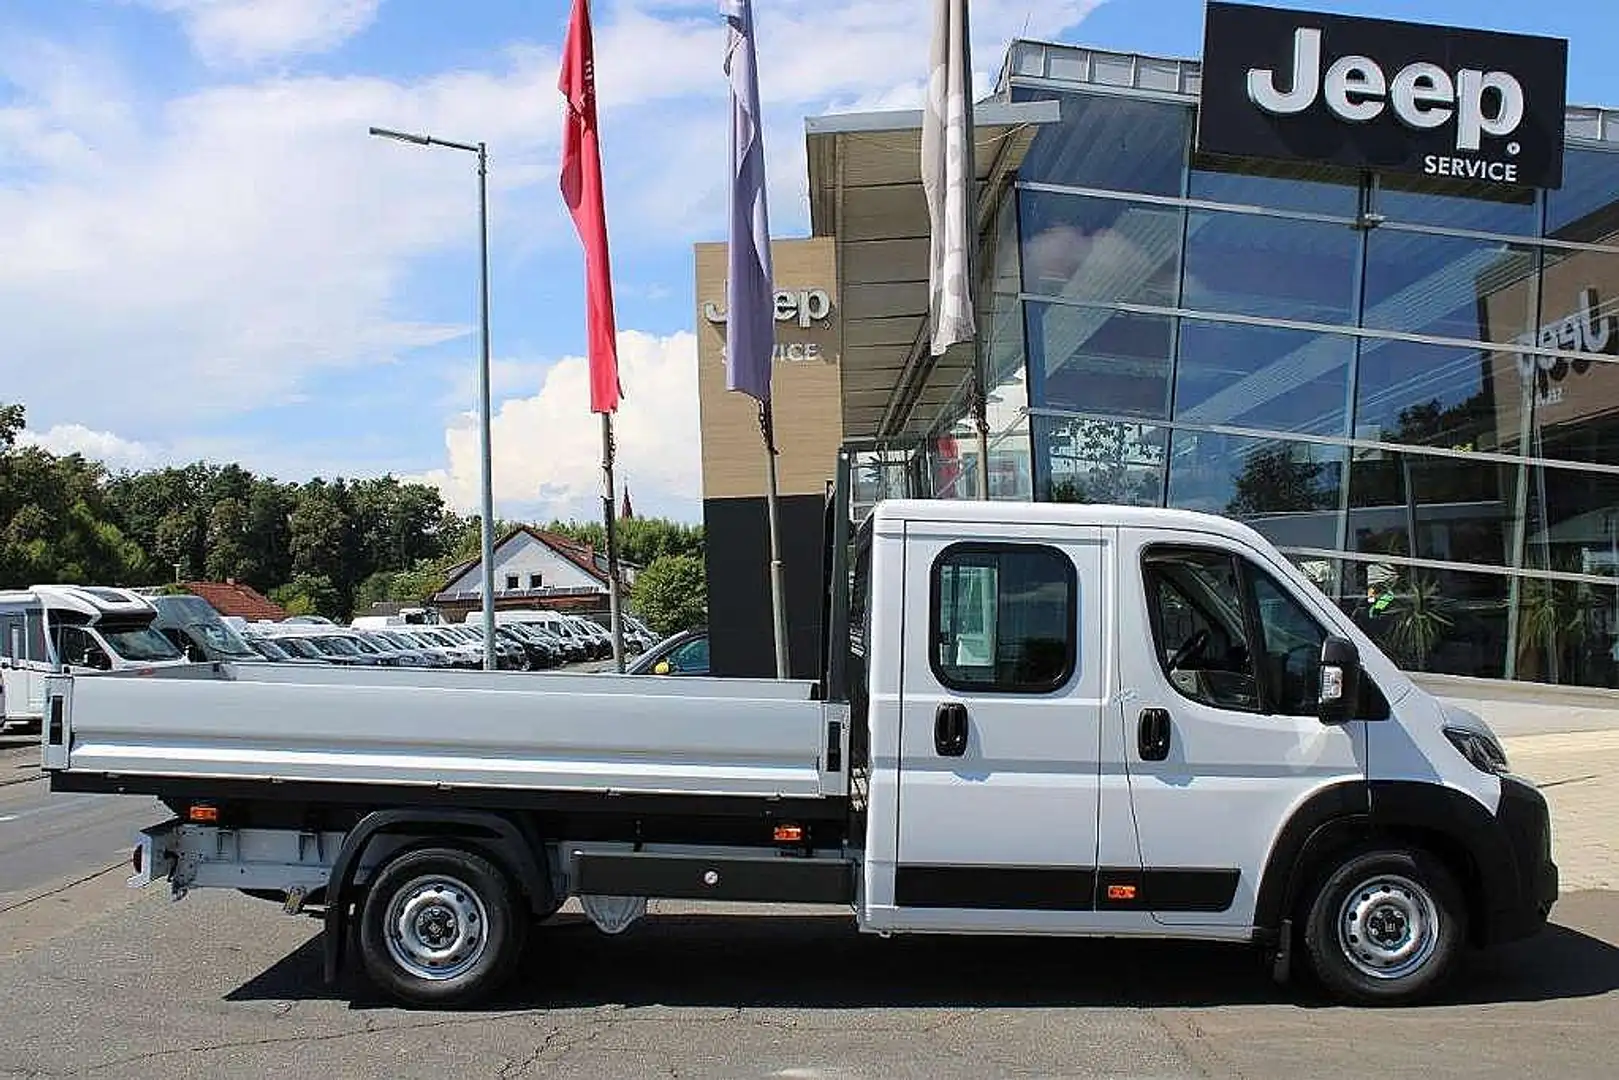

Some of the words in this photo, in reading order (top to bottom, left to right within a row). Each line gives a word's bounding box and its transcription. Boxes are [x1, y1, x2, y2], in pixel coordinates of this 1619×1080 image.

[1247, 27, 1523, 150] Jeep
[1424, 155, 1517, 182] SERVICE
[704, 279, 830, 328] ep
